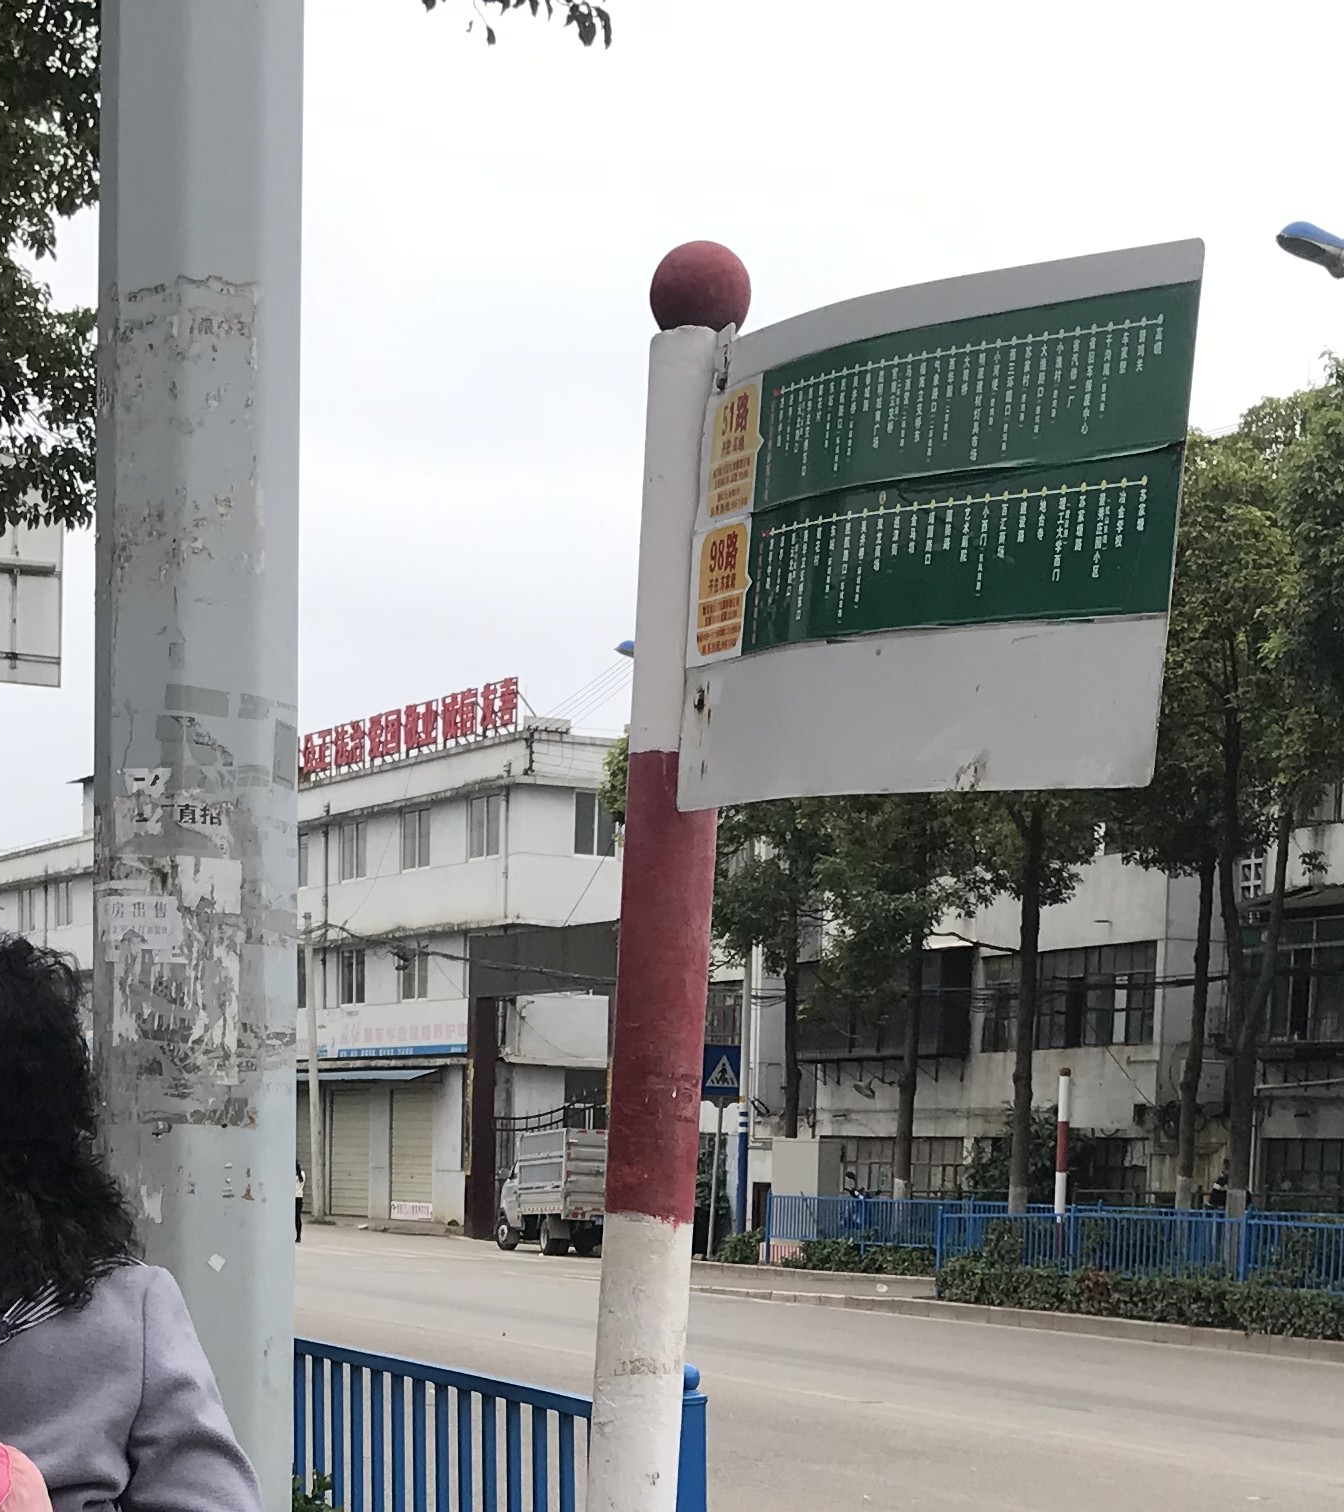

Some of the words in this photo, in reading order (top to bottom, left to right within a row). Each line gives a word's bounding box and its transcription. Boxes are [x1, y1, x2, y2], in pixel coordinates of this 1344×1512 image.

[721, 392, 749, 436] 51路
[709, 531, 738, 573] 98路
[368, 709, 401, 758] 爱国
[405, 698, 438, 749] 敬业
[441, 688, 477, 739] 诚信
[480, 676, 519, 729] 友善
